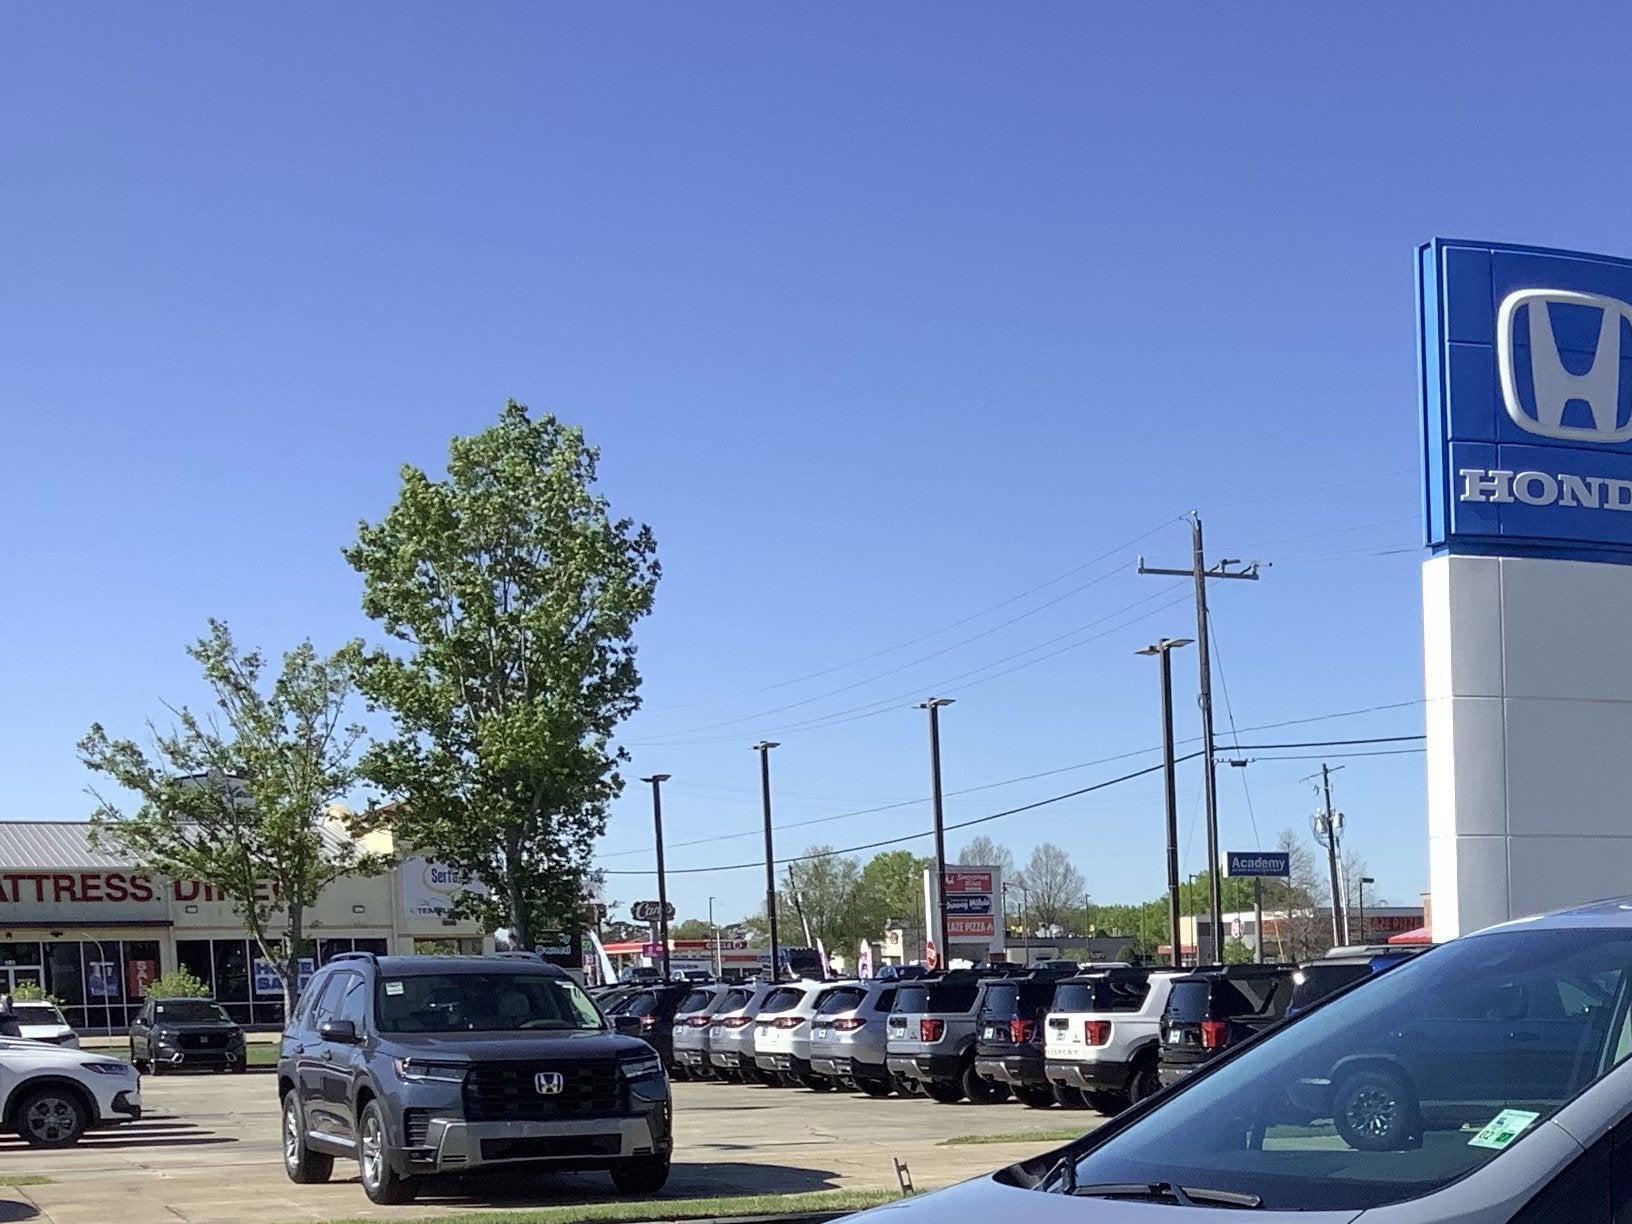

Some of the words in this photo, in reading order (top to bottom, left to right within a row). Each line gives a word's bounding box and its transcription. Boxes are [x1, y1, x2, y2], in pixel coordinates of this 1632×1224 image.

[1231, 857, 1286, 871] Academy
[431, 868, 459, 883] Serta
[947, 922, 964, 932] LAZE
[965, 921, 986, 932] PIZZA
